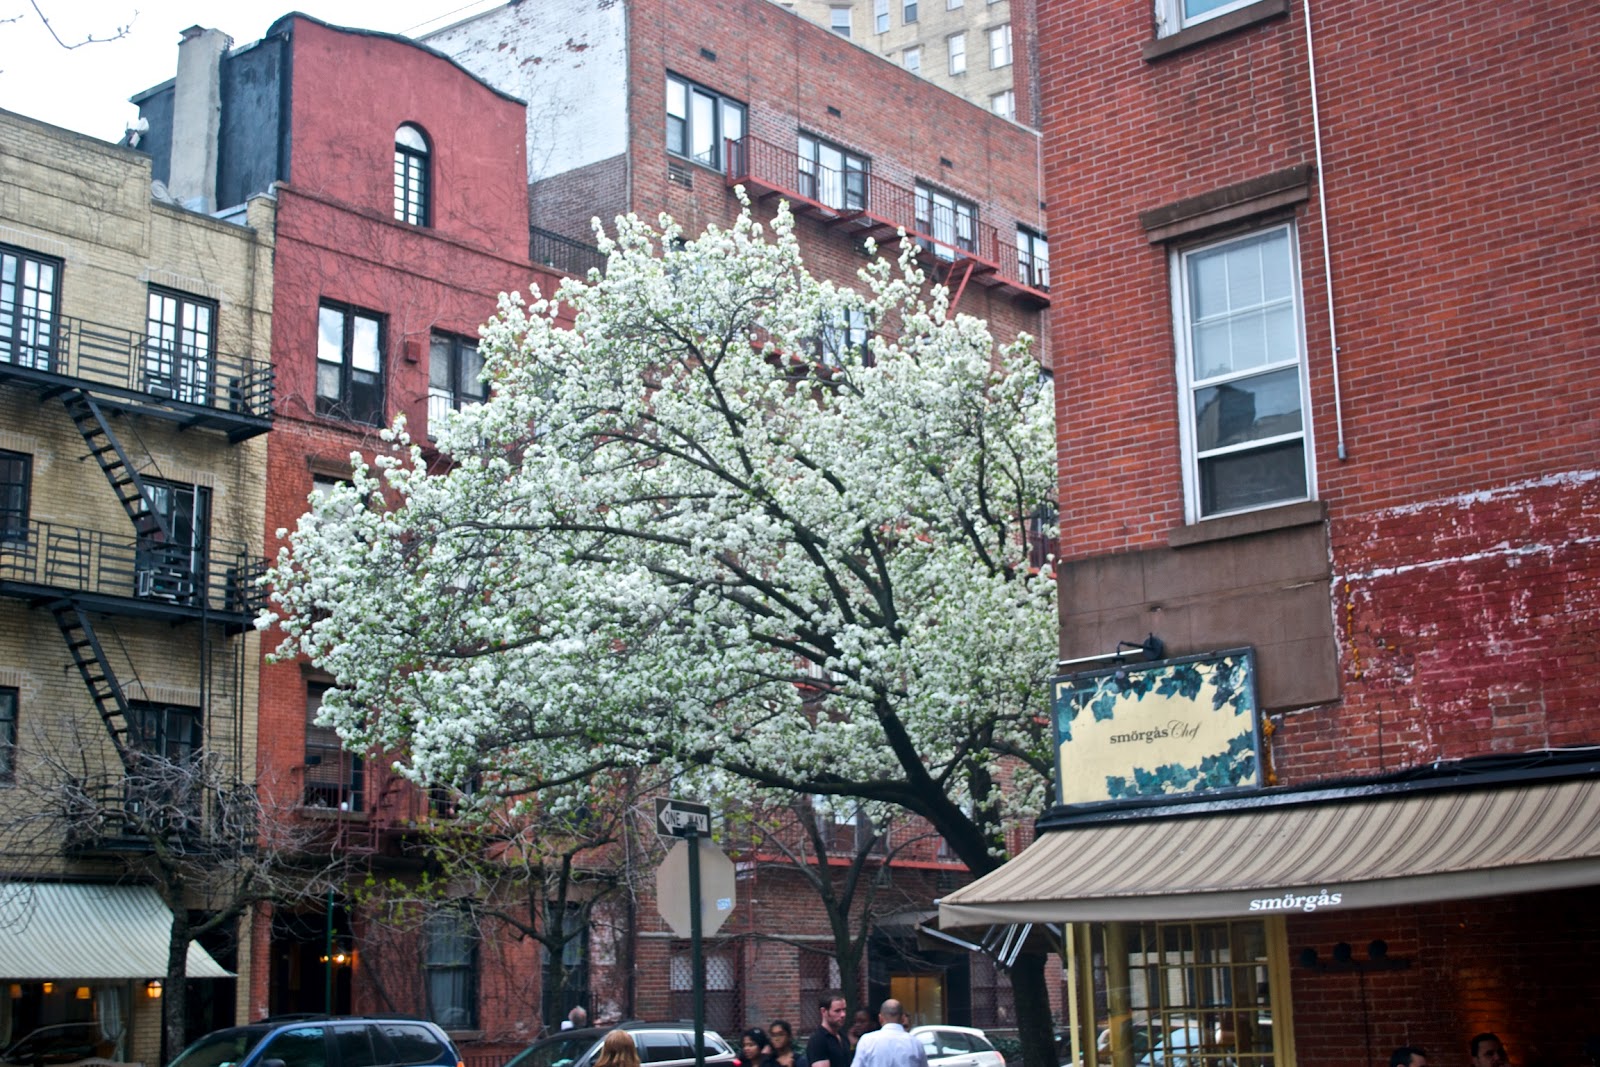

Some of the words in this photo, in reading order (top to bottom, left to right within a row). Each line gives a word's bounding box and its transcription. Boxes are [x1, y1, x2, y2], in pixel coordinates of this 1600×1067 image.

[1110, 726, 1169, 744] smörgås
[1167, 720, 1201, 743] Chef
[664, 810, 681, 826] ONE
[1249, 889, 1342, 912] smörgås
